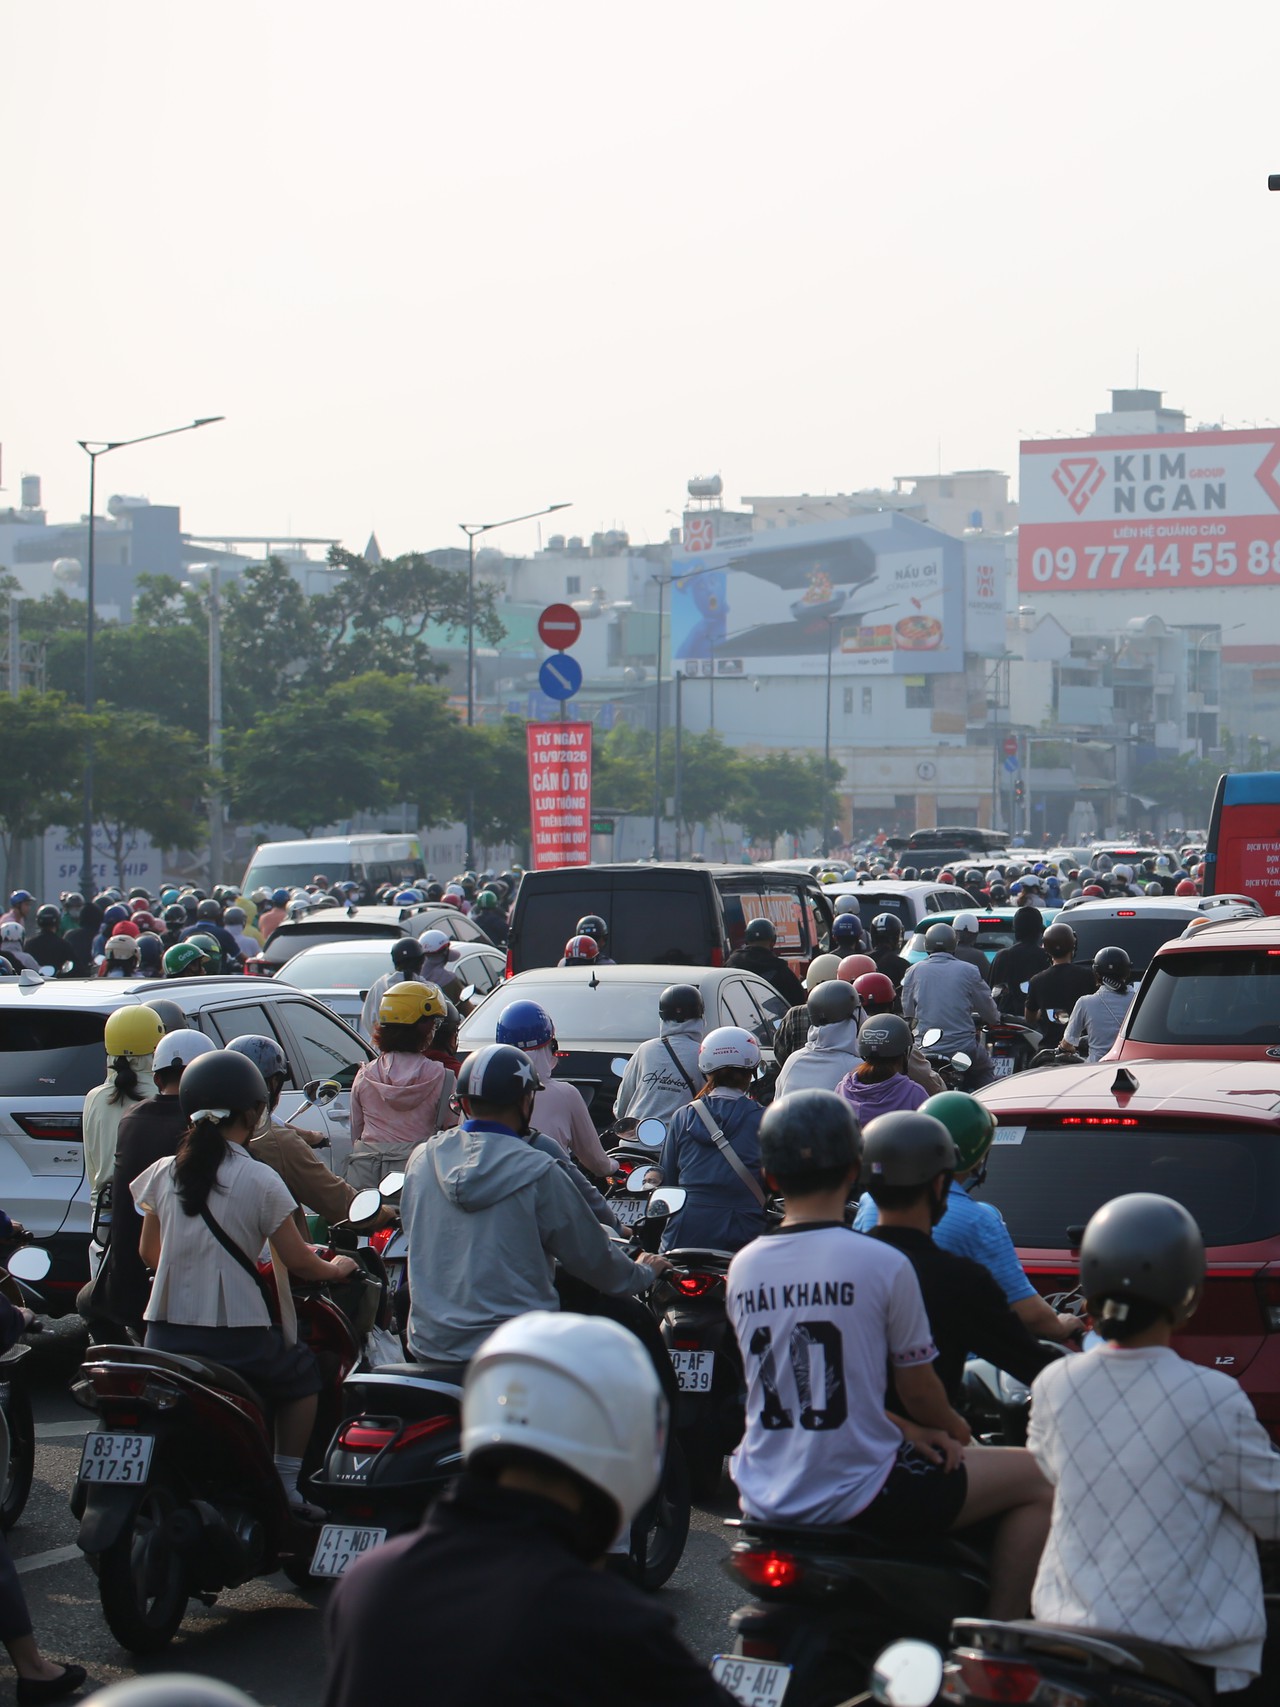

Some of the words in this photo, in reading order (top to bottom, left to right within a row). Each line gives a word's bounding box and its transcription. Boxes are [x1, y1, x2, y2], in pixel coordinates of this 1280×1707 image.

[1113, 453, 1186, 483] KIM
[1189, 467, 1225, 480] GROUP
[1113, 482, 1227, 514] NGAN
[1113, 525, 1138, 539] LIÊN
[1140, 524, 1155, 539] HỆ
[1156, 523, 1198, 537] QUẢNG
[1201, 522, 1226, 536] CÁO
[895, 564, 920, 581] NẤU
[923, 561, 937, 577] GÌ
[1032, 546, 1077, 582] 09
[1084, 545, 1130, 580] 77
[1134, 543, 1181, 578] 44
[1191, 541, 1238, 577] 55
[536, 731, 551, 746] TỪ
[553, 731, 584, 746] NGÀY
[573, 768, 588, 791] TÔ
[58, 864, 107, 878] SPCE
[178, 950, 194, 961] Grab
[737, 1283, 776, 1317] THÁI
[783, 1281, 855, 1309] KHANG
[750, 1320, 849, 1431] 10
[93, 1436, 143, 1458] 83-P3
[82, 1459, 145, 1481] 217.51
[316, 1552, 362, 1574] 412
[720, 1663, 779, 1695] 69-AH
